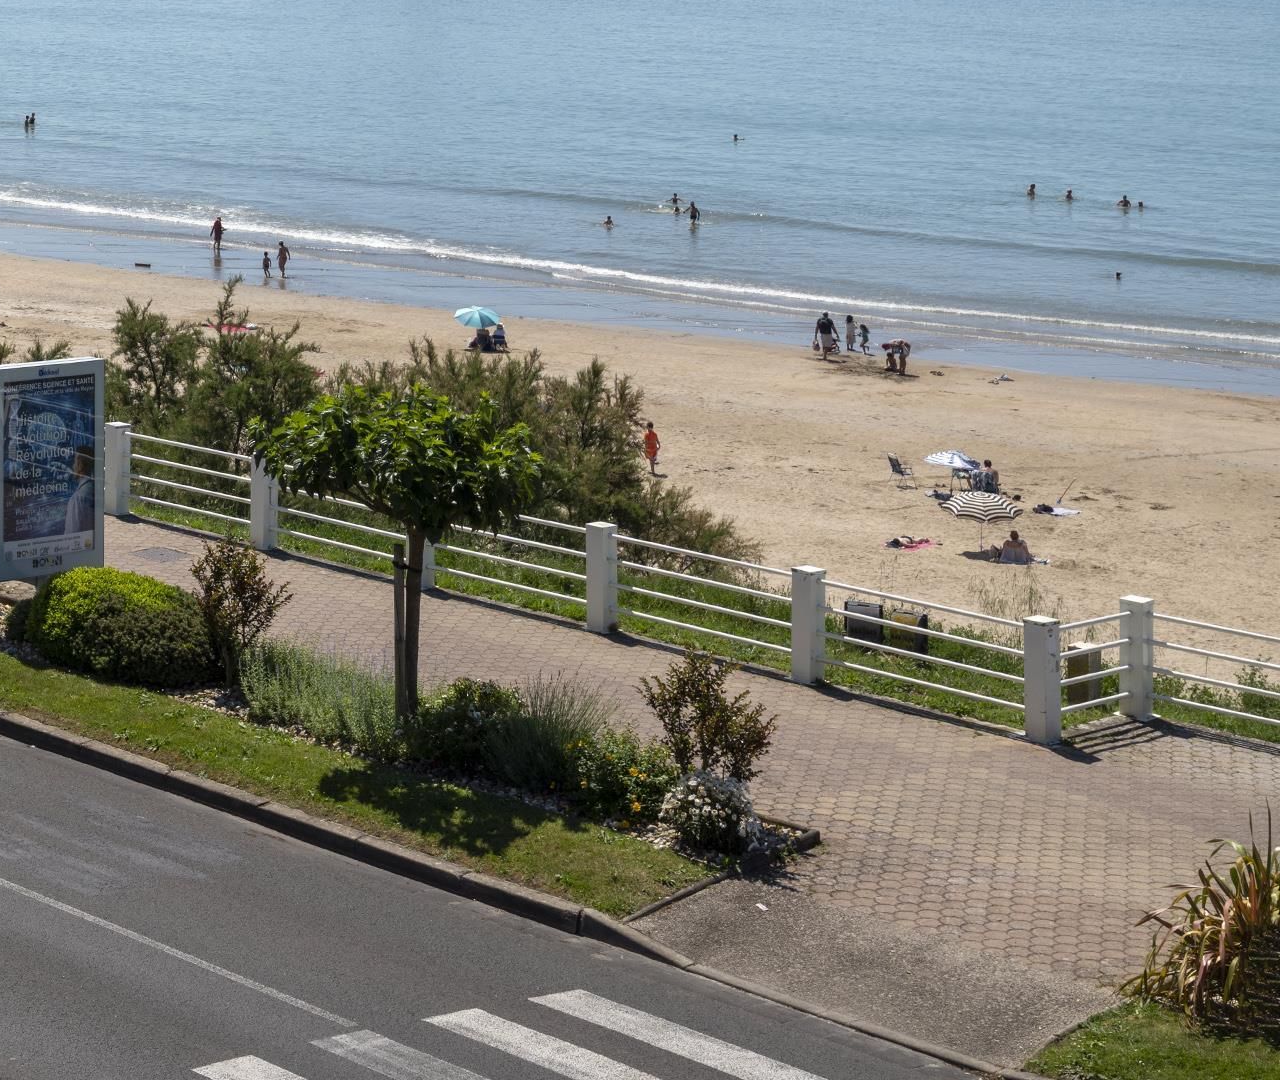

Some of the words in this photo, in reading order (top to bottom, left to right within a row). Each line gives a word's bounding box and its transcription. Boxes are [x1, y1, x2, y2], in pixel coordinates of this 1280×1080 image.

[42, 379, 67, 389] SCIENCE
[67, 378, 75, 386] ET
[16, 446, 74, 461] Révolution
[15, 467, 30, 480] de
[32, 464, 42, 478] la
[15, 481, 69, 497] médecine
